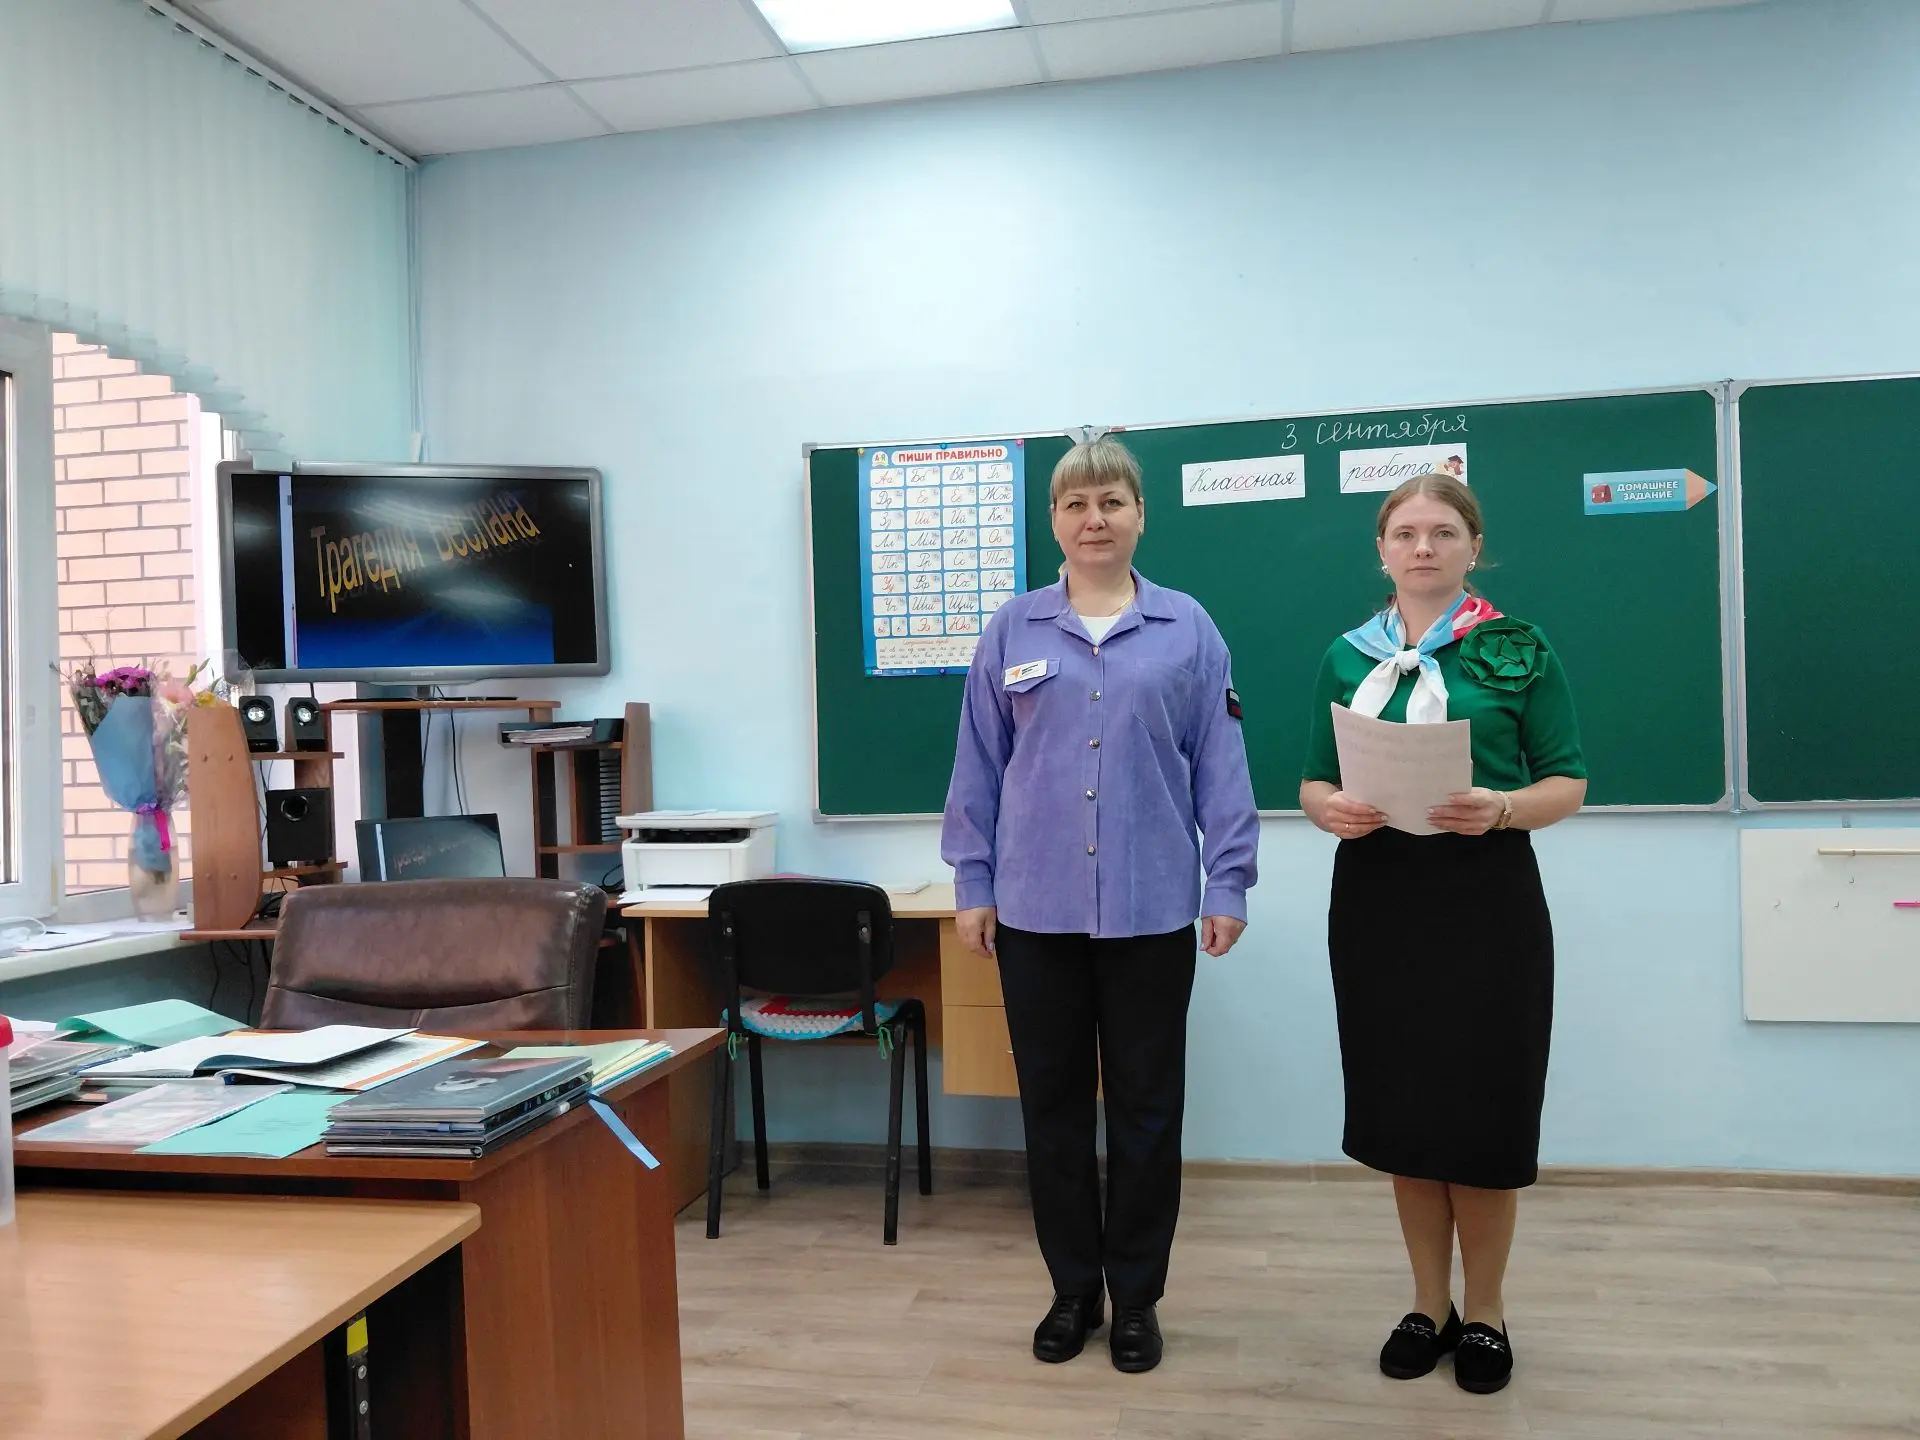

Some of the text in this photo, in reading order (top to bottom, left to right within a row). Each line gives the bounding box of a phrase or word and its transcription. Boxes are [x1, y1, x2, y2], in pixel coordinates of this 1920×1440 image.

[1281, 424, 1298, 450] 3
[898, 448, 1003, 463] ПИШИ ПРАВИЛЬНО
[1189, 466, 1296, 493] Классная
[1341, 452, 1435, 490] работа
[1616, 481, 1679, 492] ДОМАШНЕЕ
[1623, 490, 1673, 501] ЗАДАНИЕ
[311, 526, 426, 613] Трагедия
